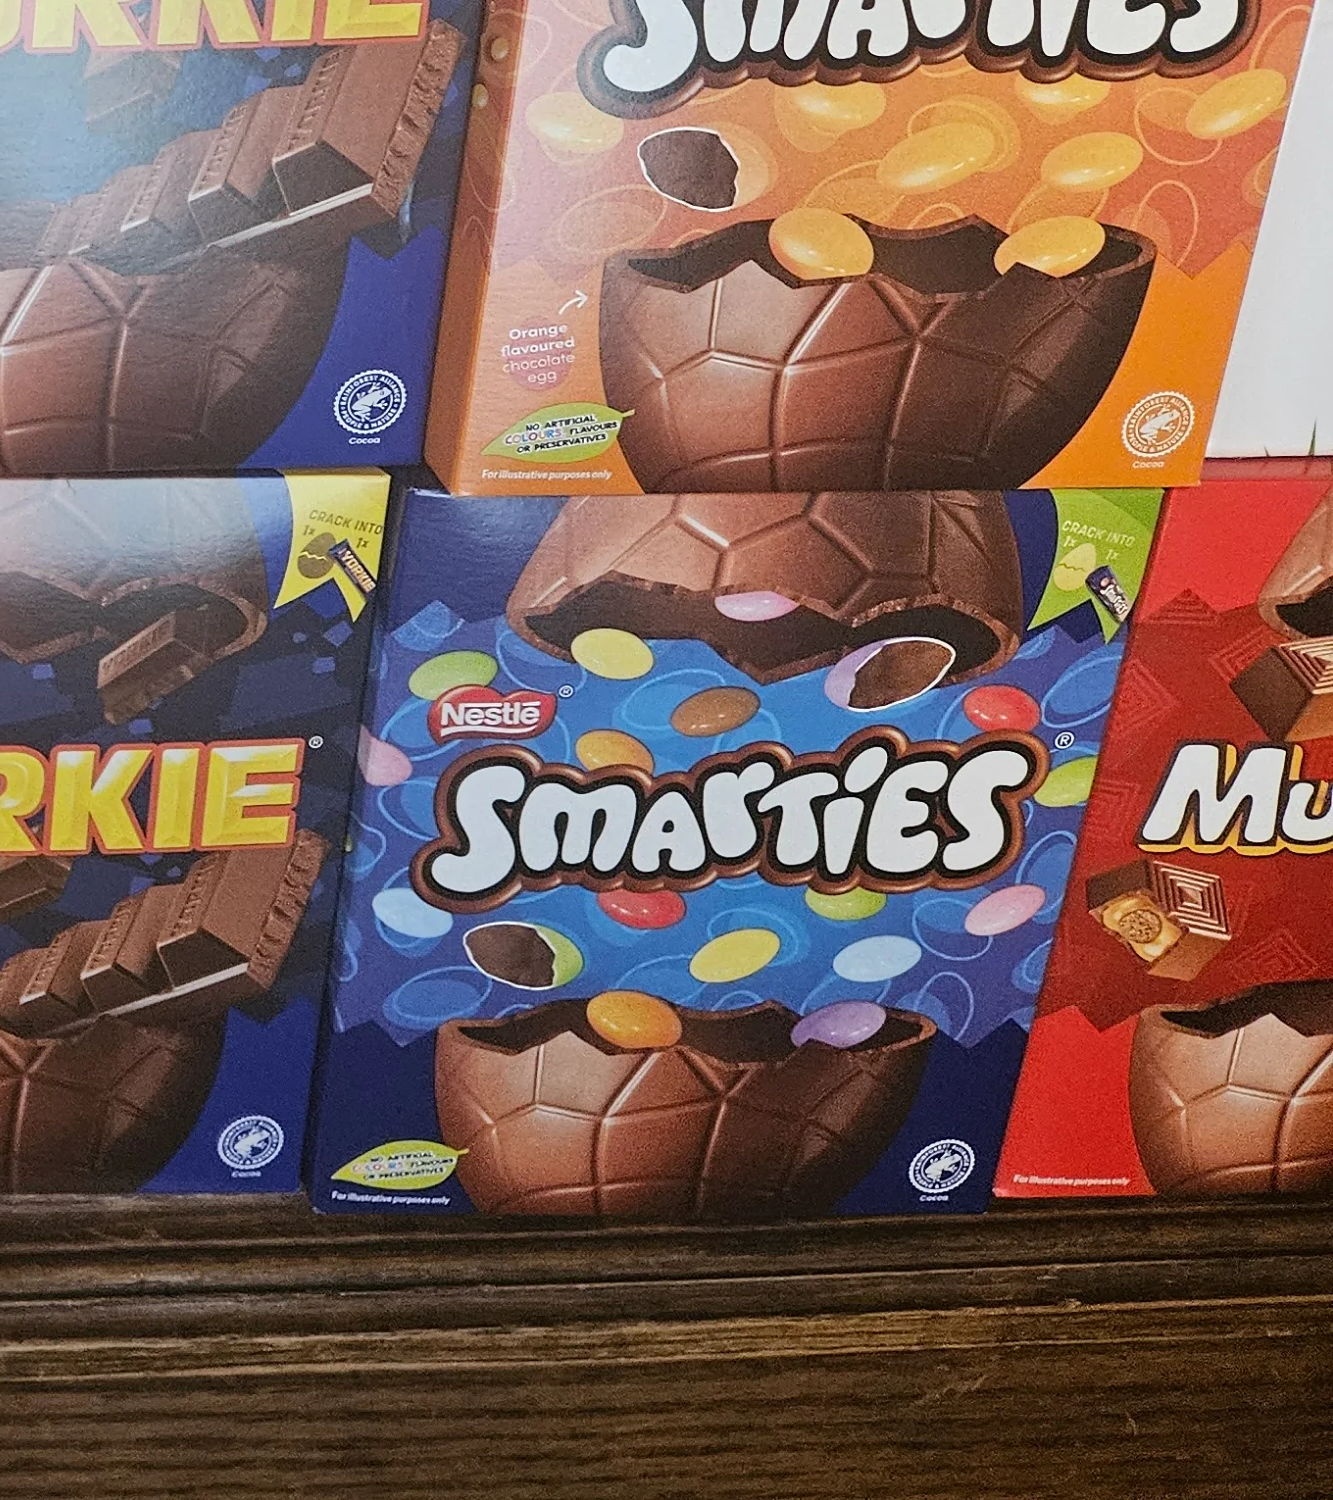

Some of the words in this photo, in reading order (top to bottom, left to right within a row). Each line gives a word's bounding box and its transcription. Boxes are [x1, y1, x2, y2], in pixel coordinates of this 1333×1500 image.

[508, 323, 569, 341] Orange
[501, 337, 575, 357] flavoured
[502, 353, 575, 374] chocolate
[527, 369, 558, 385] egg
[505, 429, 562, 444] COLOURS
[570, 421, 618, 435] FLAVOURS
[526, 423, 539, 432] NO
[544, 414, 595, 429] ARTIFICIAL
[348, 437, 380, 445] Cocoa
[517, 445, 531, 454] OR
[534, 433, 607, 451] PRESERVATIVES
[482, 469, 498, 479] For
[498, 469, 549, 480] illustrative
[549, 471, 590, 481] purposes
[591, 470, 612, 481] only
[309, 509, 352, 531] CRACK
[354, 519, 384, 536] INTO
[355, 536, 369, 549] 1x
[1061, 520, 1104, 541] CRACK
[1106, 530, 1136, 547] INTO
